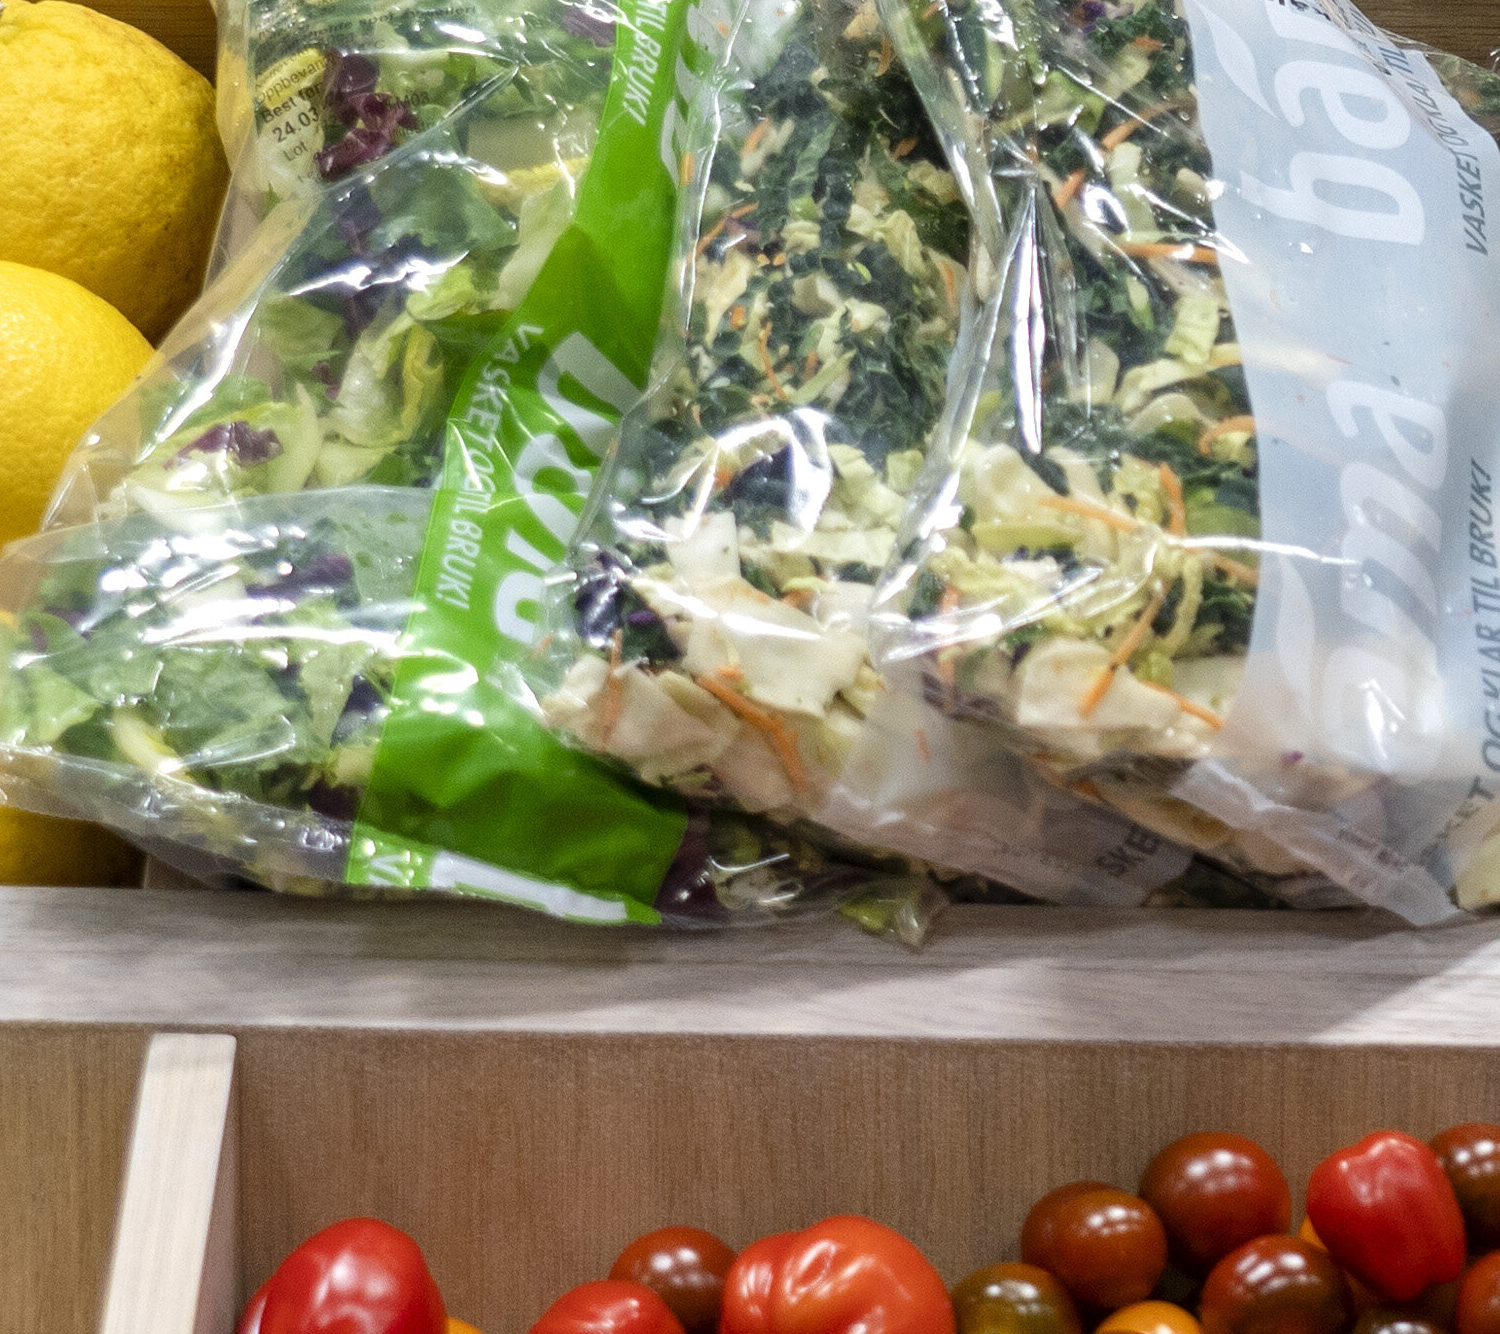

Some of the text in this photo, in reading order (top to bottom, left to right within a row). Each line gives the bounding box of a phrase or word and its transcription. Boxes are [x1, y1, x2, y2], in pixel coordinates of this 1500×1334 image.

[621, 31, 663, 127] BRUK!
[1450, 150, 1488, 257] VASKET
[465, 323, 546, 455] VASKET
[1468, 457, 1499, 570] BRUK!
[433, 518, 483, 611] BRUK!
[1469, 575, 1500, 619] TIL
